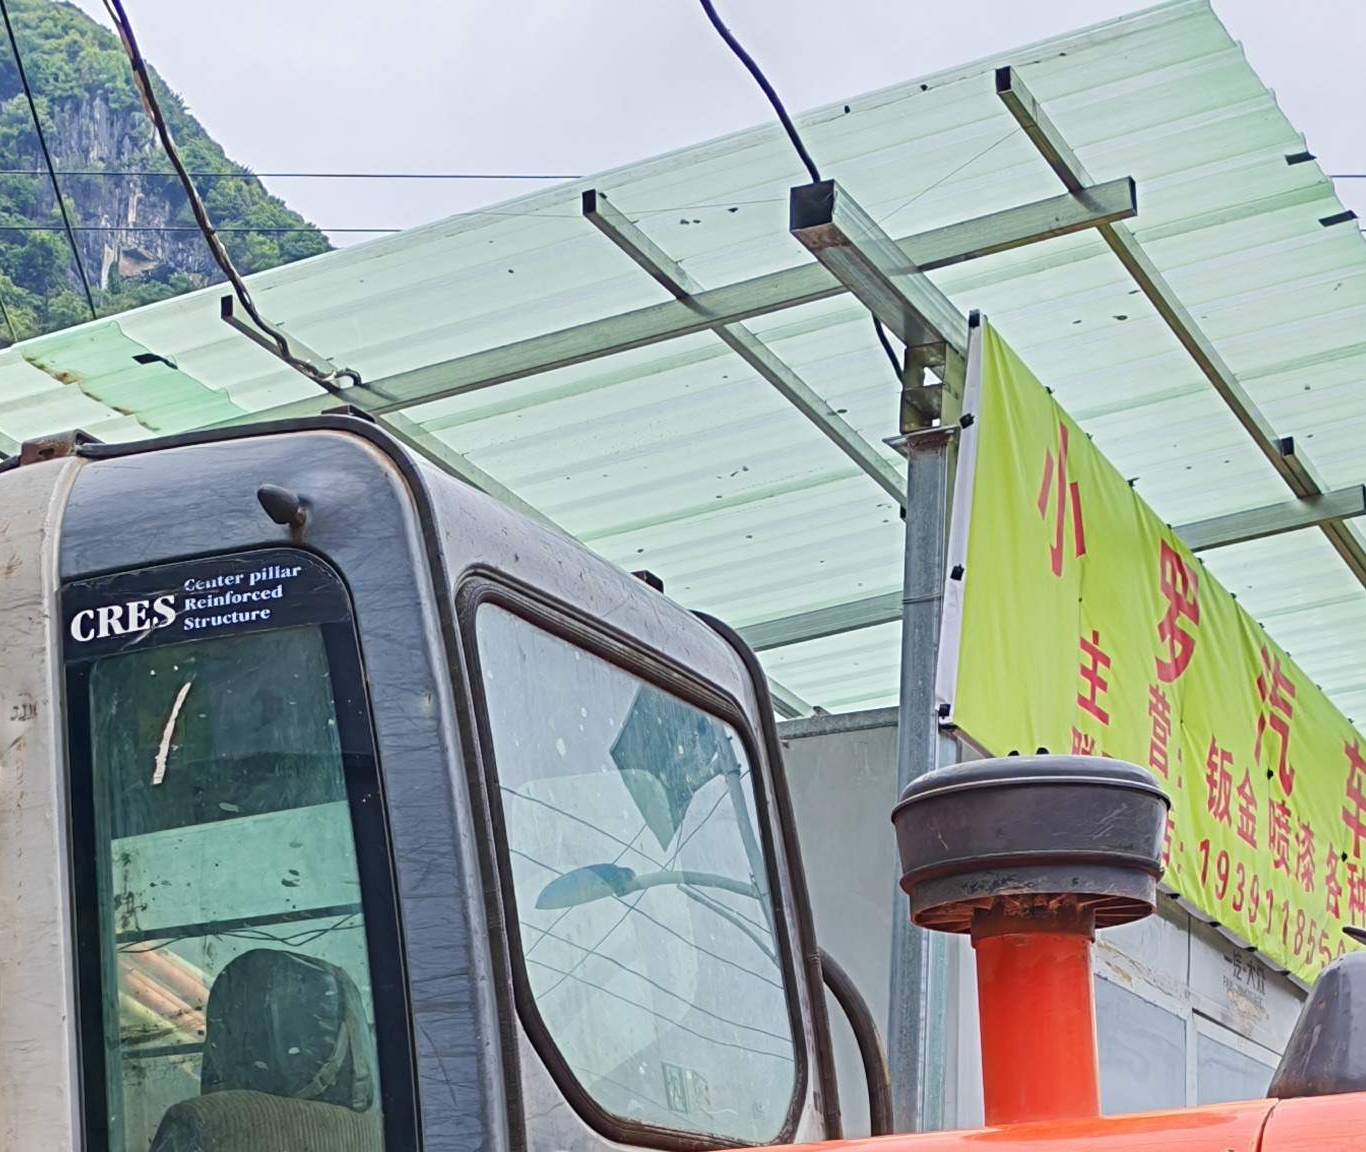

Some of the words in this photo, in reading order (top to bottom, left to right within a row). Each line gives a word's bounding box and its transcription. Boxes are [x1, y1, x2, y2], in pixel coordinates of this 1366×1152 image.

[184, 575, 244, 592] Center
[249, 564, 302, 586] pillar
[184, 584, 284, 611] Reinforced
[70, 594, 177, 643] CRES
[184, 607, 271, 631] Structure
